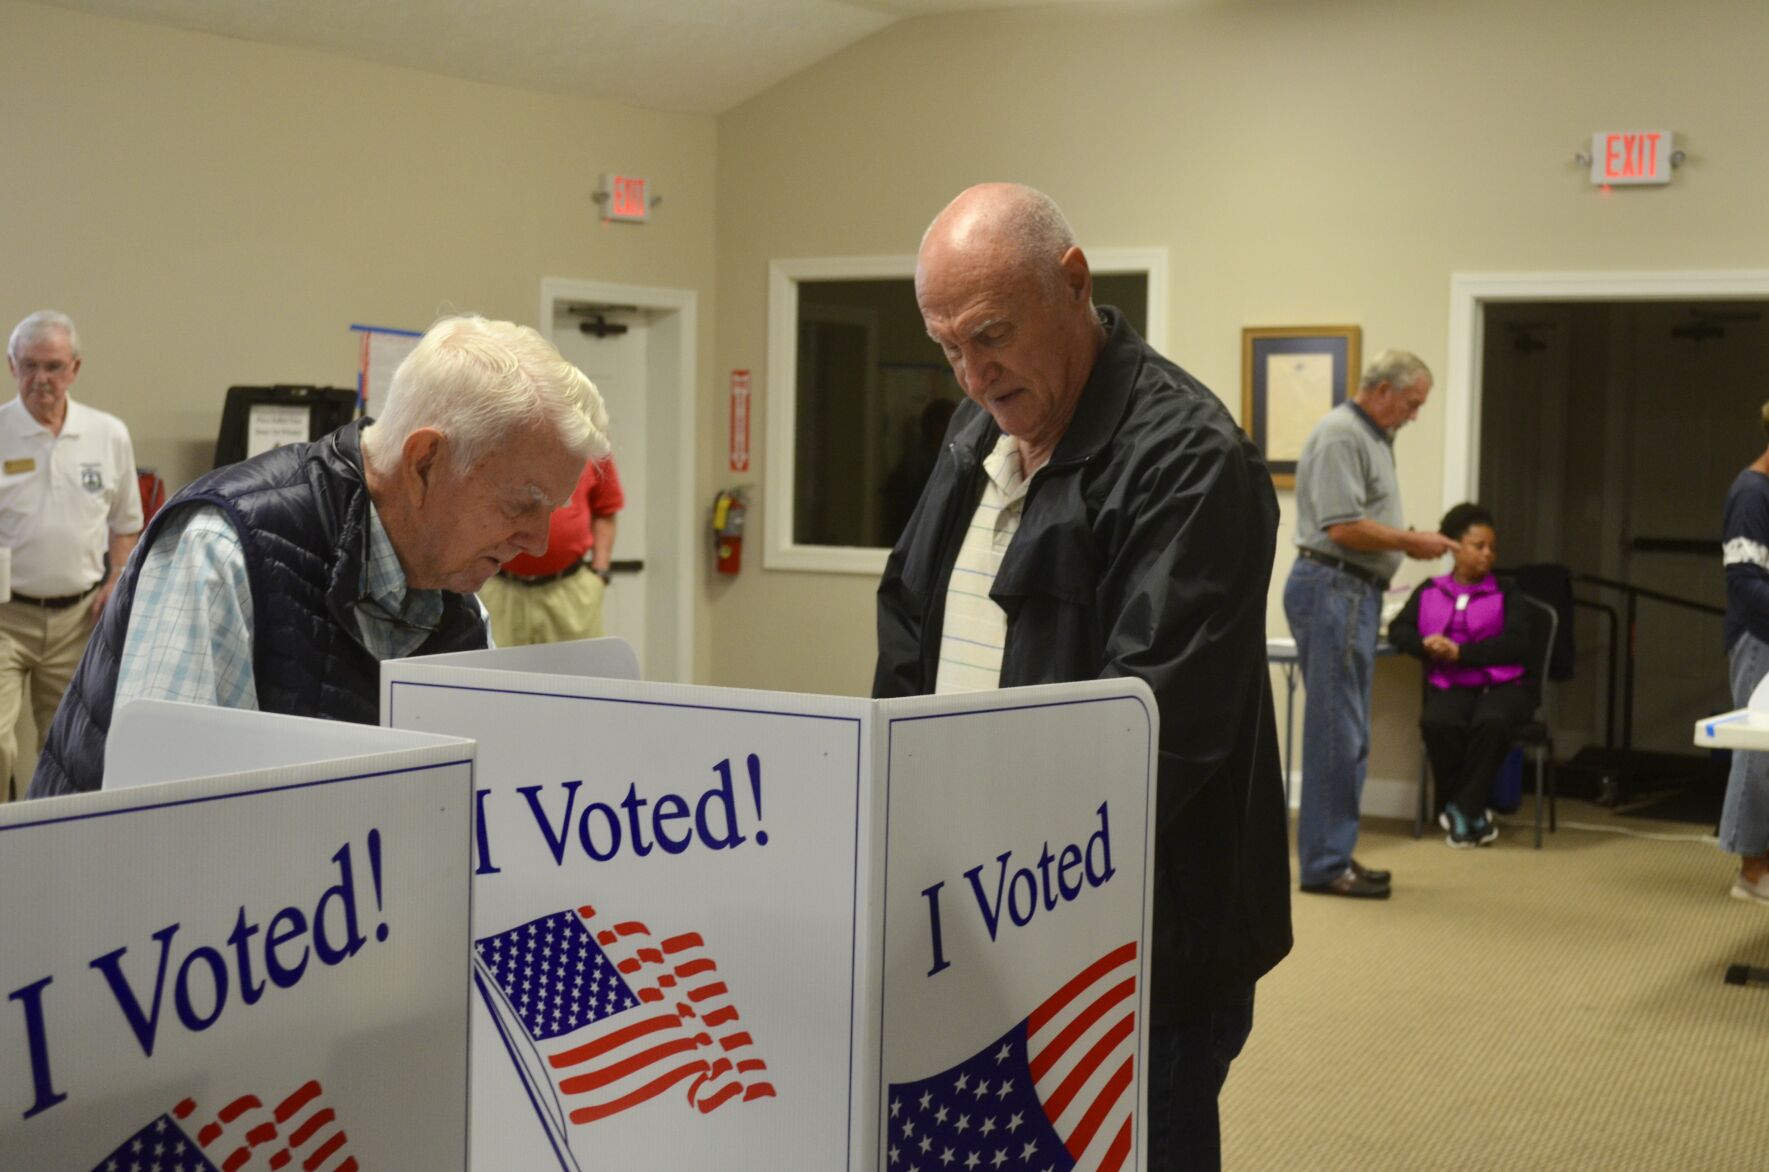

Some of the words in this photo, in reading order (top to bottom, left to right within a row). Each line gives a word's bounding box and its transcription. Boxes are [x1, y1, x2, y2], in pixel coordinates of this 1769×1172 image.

[1605, 133, 1662, 177] EXIT
[475, 789, 501, 875] I
[516, 753, 770, 867] Voted!
[921, 880, 951, 978] I
[963, 801, 1117, 943] Voted
[8, 975, 69, 1120] I
[89, 828, 389, 1059] Voted!
